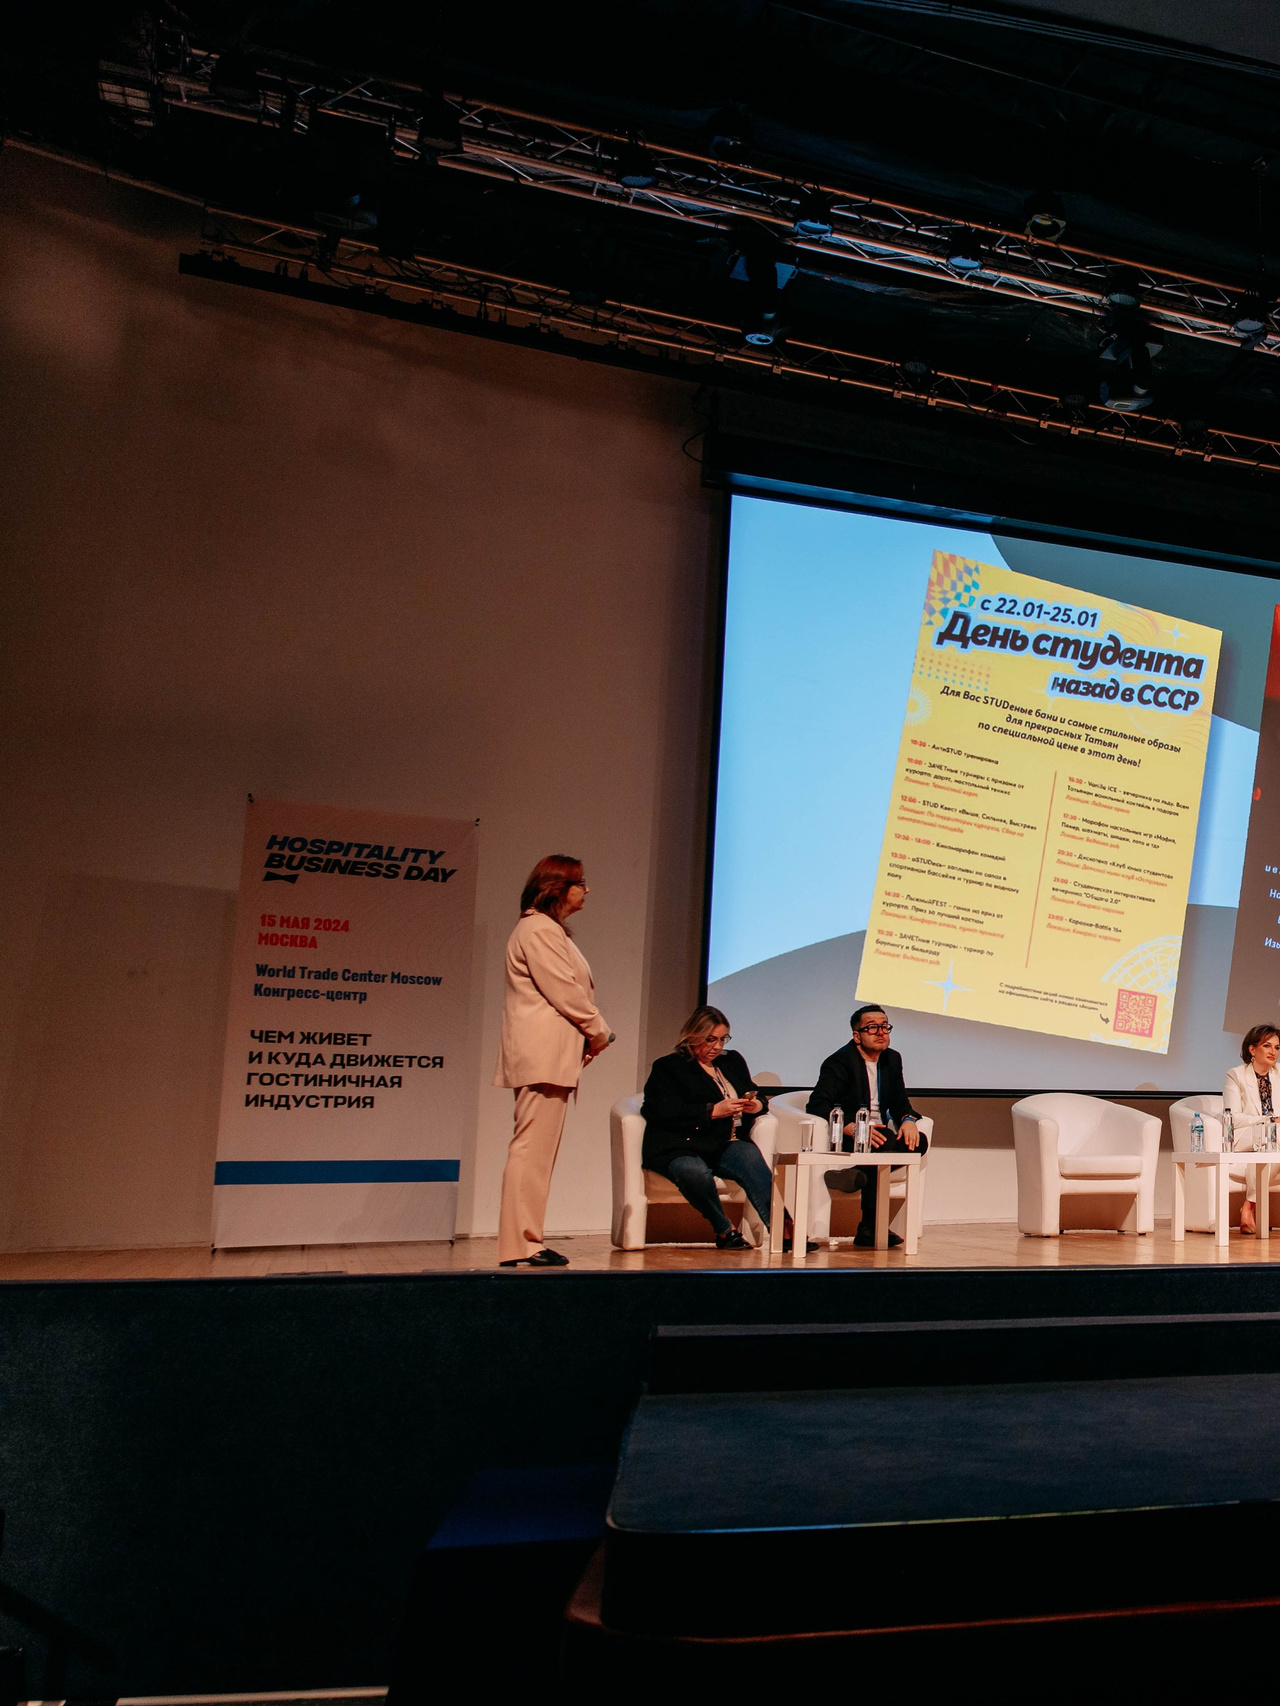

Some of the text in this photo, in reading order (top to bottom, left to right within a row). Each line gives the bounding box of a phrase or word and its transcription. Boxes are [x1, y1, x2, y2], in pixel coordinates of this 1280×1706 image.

[980, 597, 1098, 628] с 22.01-25.01
[936, 610, 1204, 679] День студента
[1051, 677, 1199, 711] назад в СССР
[939, 685, 960, 697] Для
[962, 690, 981, 702] Вас
[1034, 708, 1058, 721] бани
[1067, 719, 1097, 731] самые
[1098, 727, 1145, 744] стильные
[1147, 738, 1181, 753] образы
[1005, 713, 1118, 749] для прекрасных Татьян
[977, 722, 990, 730] по
[991, 725, 1054, 746] специальной
[1056, 741, 1078, 752] цене
[1087, 748, 1114, 761] этот
[1116, 753, 1141, 767] день!
[265, 834, 445, 864] HOSPITALITY
[263, 852, 457, 882] BUSINESS DAY
[260, 913, 349, 932] 15 МАЯ 2024
[257, 932, 317, 948] МОСКВА
[255, 963, 442, 985] World Trade Center Moscow
[253, 983, 367, 1004] Конгресс-центр
[250, 1029, 371, 1046] ЧЕМ ЖИВЕТ
[248, 1051, 443, 1069] И КУДА ДВИЖЕТСЯ
[246, 1072, 402, 1088] ГОСТИНИЧНАЯ
[244, 1094, 374, 1110] ИНДУСТРИЯ
